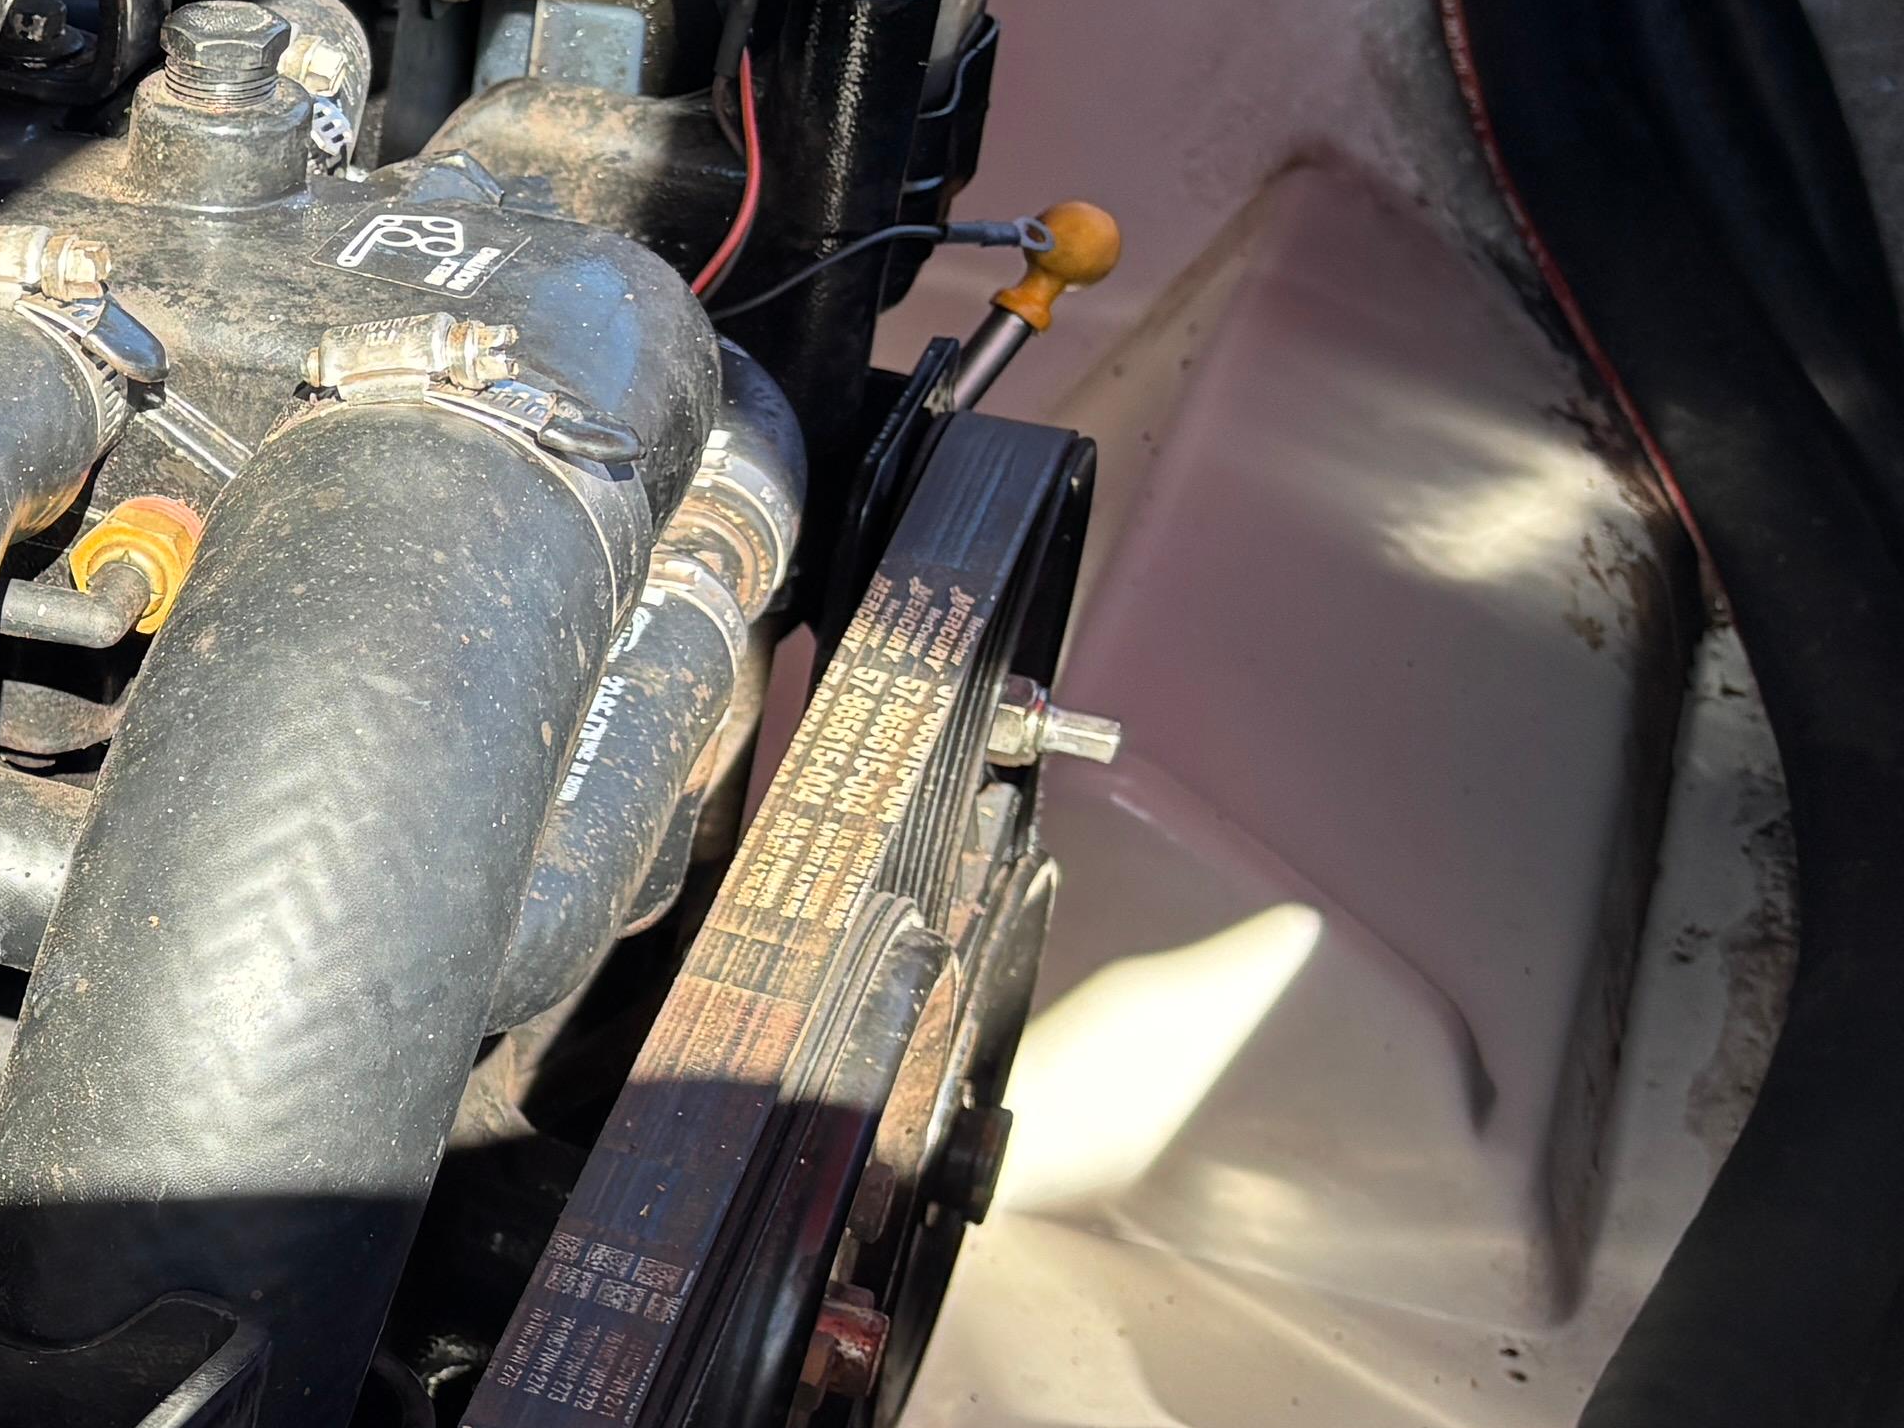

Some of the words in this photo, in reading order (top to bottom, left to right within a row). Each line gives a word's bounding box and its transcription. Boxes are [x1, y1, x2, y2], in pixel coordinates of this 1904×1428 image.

[840, 571, 892, 653] MERCURY
[881, 575, 934, 663] MERCURY
[923, 585, 975, 672] MERCURY
[789, 667, 887, 808] 57-865615-004
[832, 676, 929, 818] 57-865615-004
